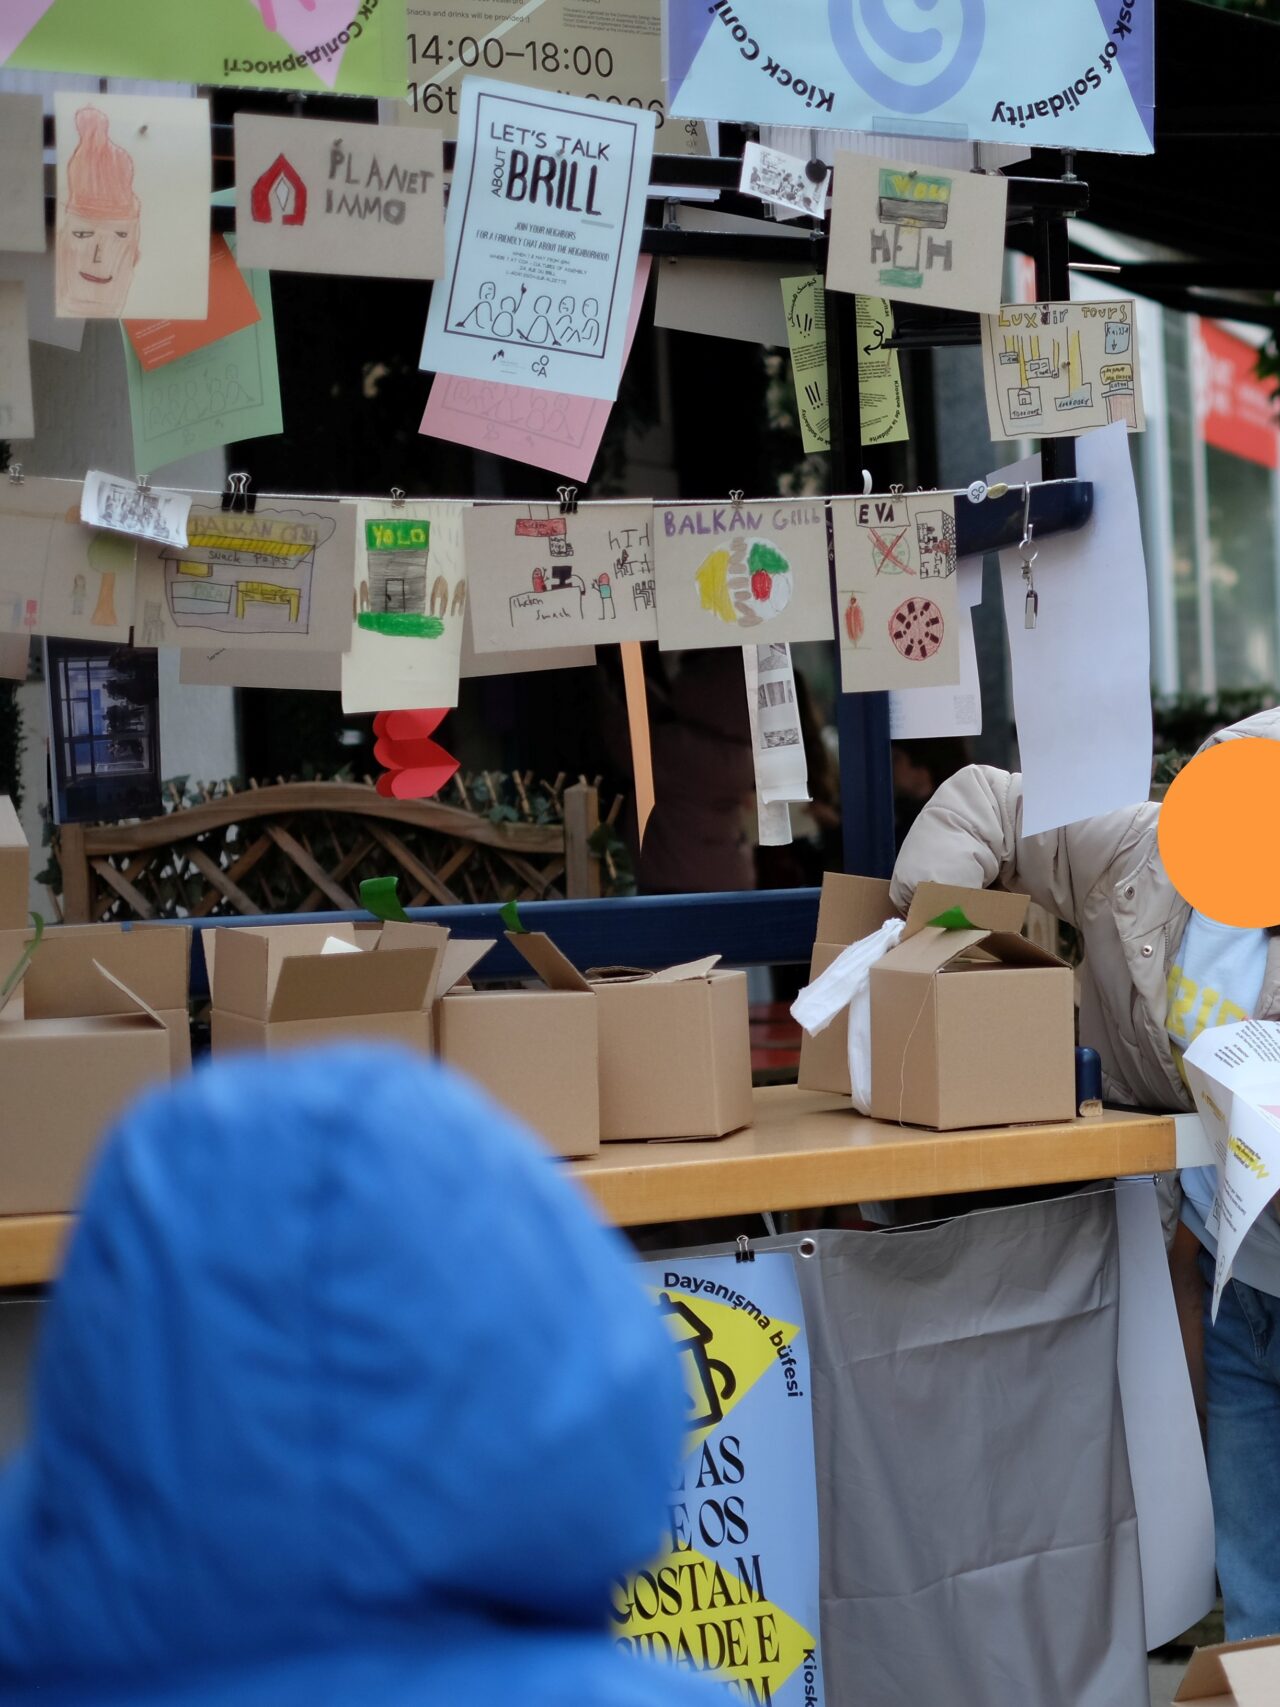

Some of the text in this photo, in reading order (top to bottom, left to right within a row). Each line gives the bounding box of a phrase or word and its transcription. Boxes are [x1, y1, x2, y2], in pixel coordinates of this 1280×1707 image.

[406, 8, 433, 18] Snacks
[433, 10, 446, 18] and
[448, 11, 469, 20] drinks
[485, 14, 493, 22] be
[494, 15, 523, 25] provided
[223, 22, 363, 77] Солідарності
[1099, 41, 1117, 74] of
[407, 82, 458, 115] 16t
[762, 56, 836, 113] Кіоск
[991, 67, 1103, 128] Solidarity
[490, 122, 611, 162] LET'S TALK
[329, 148, 434, 195] PLANET
[492, 148, 506, 197] ABOUT
[505, 149, 603, 216] BRILL
[325, 189, 406, 226] IMMO
[515, 222, 577, 240] JOIN YOUR NEIGHBORS
[476, 230, 489, 240] FOR
[495, 232, 522, 246] FRIENDLY
[523, 238, 539, 250] CHAT
[539, 240, 557, 252] ABOUT
[557, 243, 567, 254] THE
[664, 509, 763, 537] BALKAN
[859, 503, 895, 523] EVA
[664, 1272, 804, 1398] Dayanışma büfesi
[695, 1434, 745, 1488] AS
[700, 1495, 749, 1549] OS
[607, 1554, 768, 1625] GOSTAM
[754, 1613, 780, 1664] E
